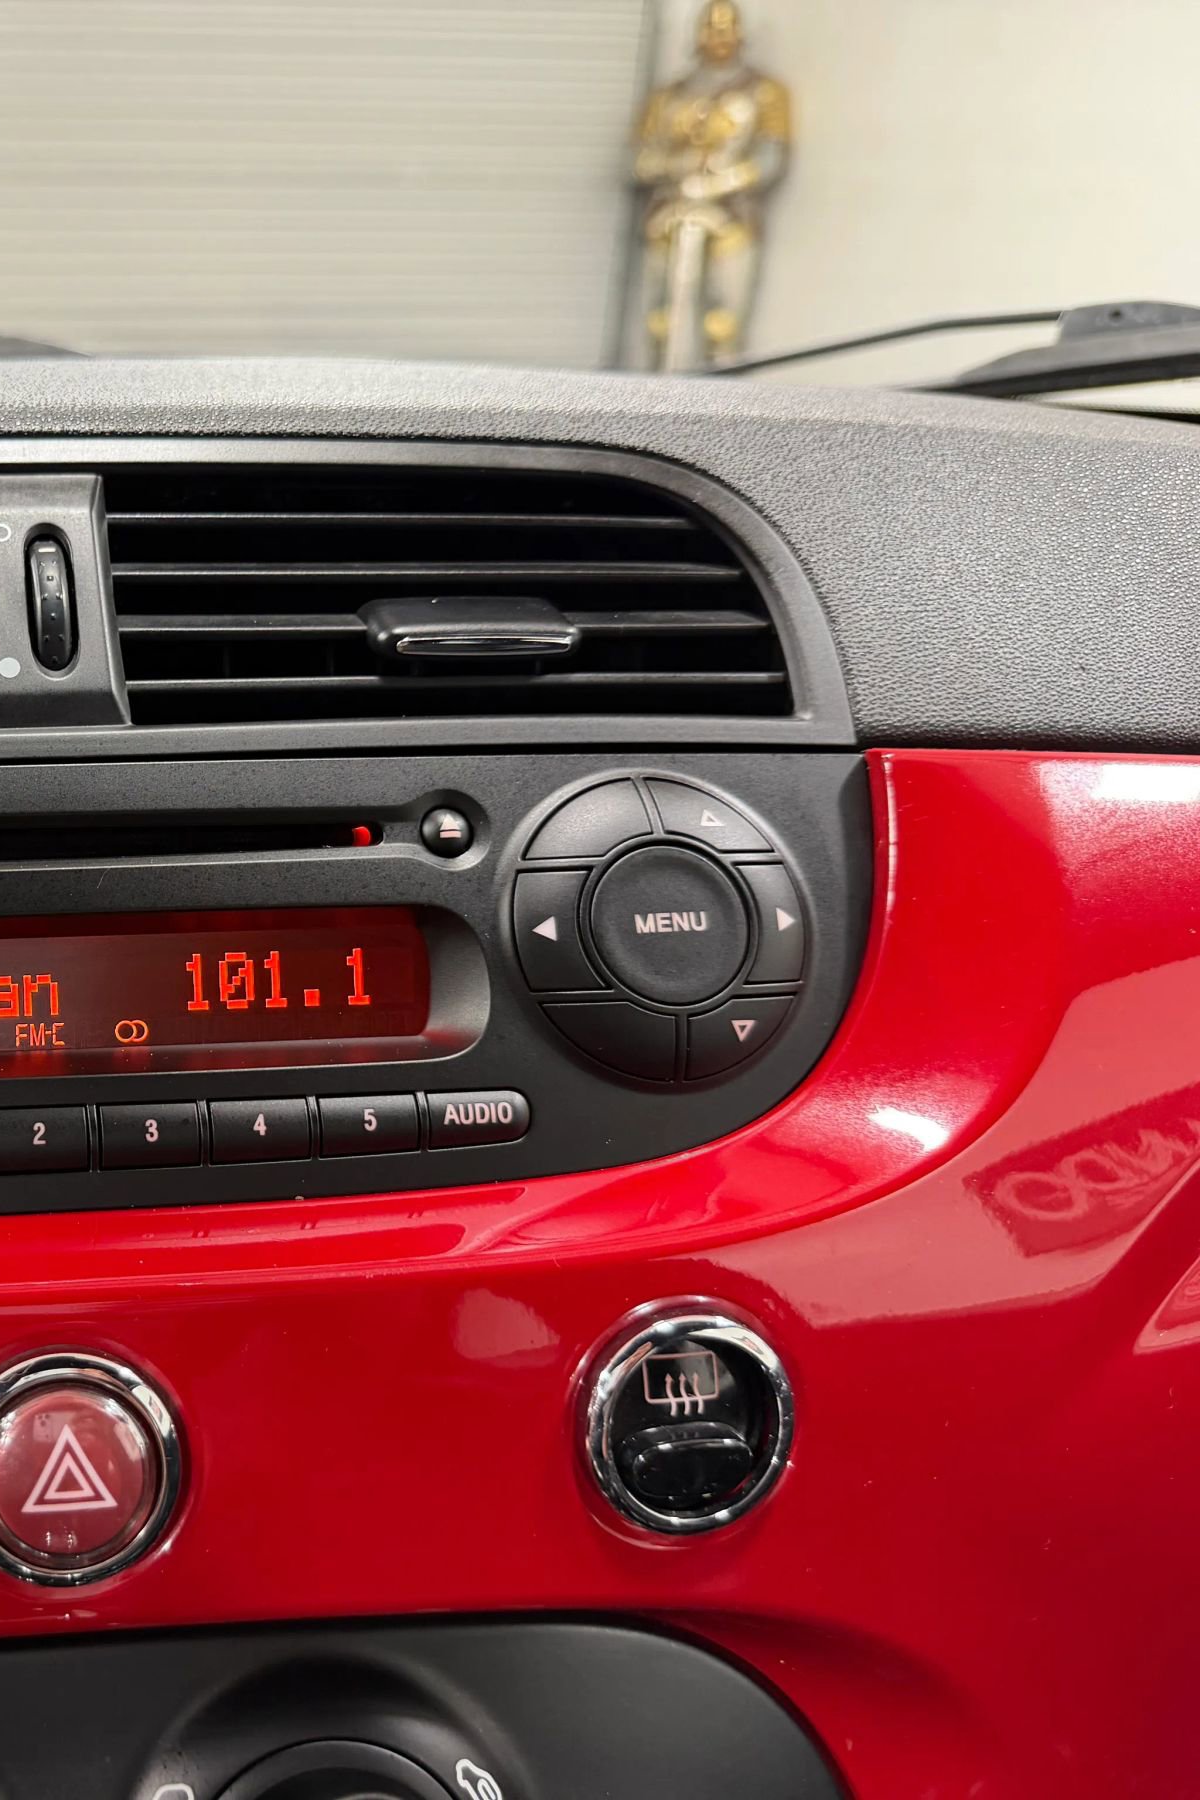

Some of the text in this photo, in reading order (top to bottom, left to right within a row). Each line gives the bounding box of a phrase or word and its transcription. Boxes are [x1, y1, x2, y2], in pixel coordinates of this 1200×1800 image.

[634, 911, 707, 934] MENU
[186, 947, 371, 1011] 101.1
[253, 1113, 268, 1136] 4
[363, 1109, 378, 1132] 5
[443, 1101, 513, 1125] AUDIO
[32, 1122, 47, 1145] 2
[145, 1119, 159, 1142] 3
